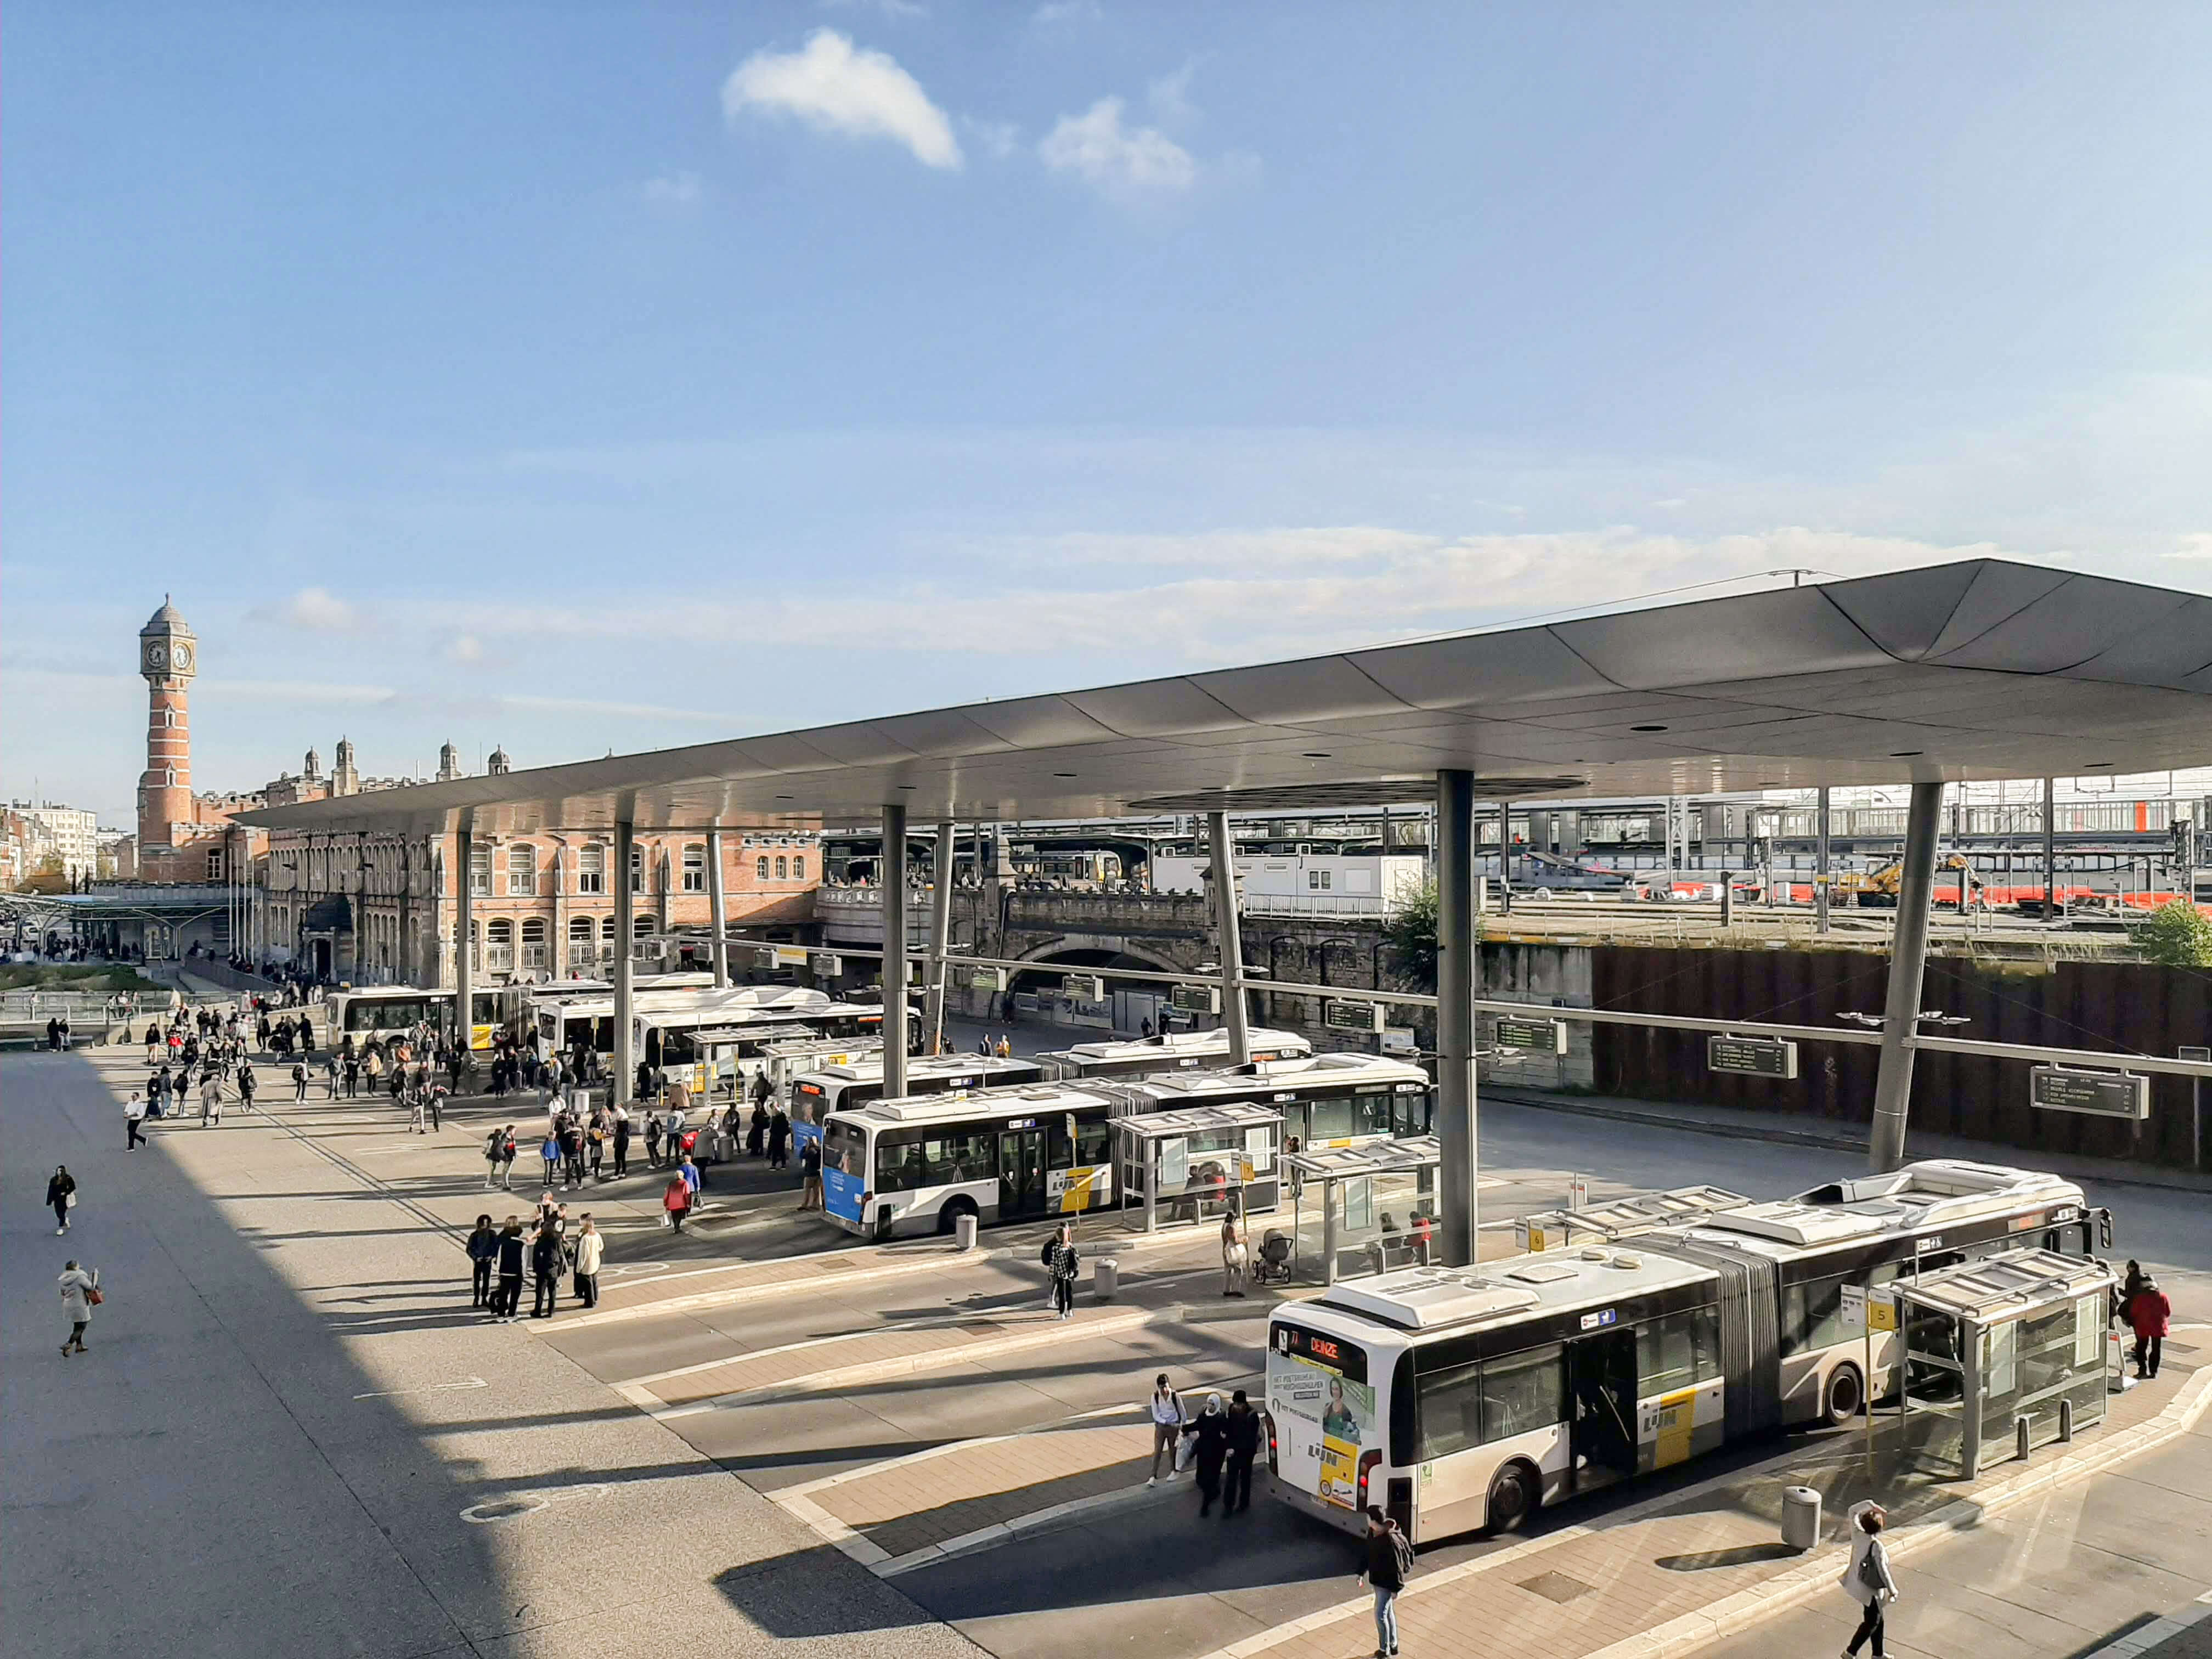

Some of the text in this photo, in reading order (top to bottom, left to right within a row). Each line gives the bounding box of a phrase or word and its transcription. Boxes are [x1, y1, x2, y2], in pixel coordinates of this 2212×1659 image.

[1535, 1235, 1539, 1244] 6
[1877, 1310, 1886, 1321] 5
[1311, 1337, 1339, 1359] DEINZE
